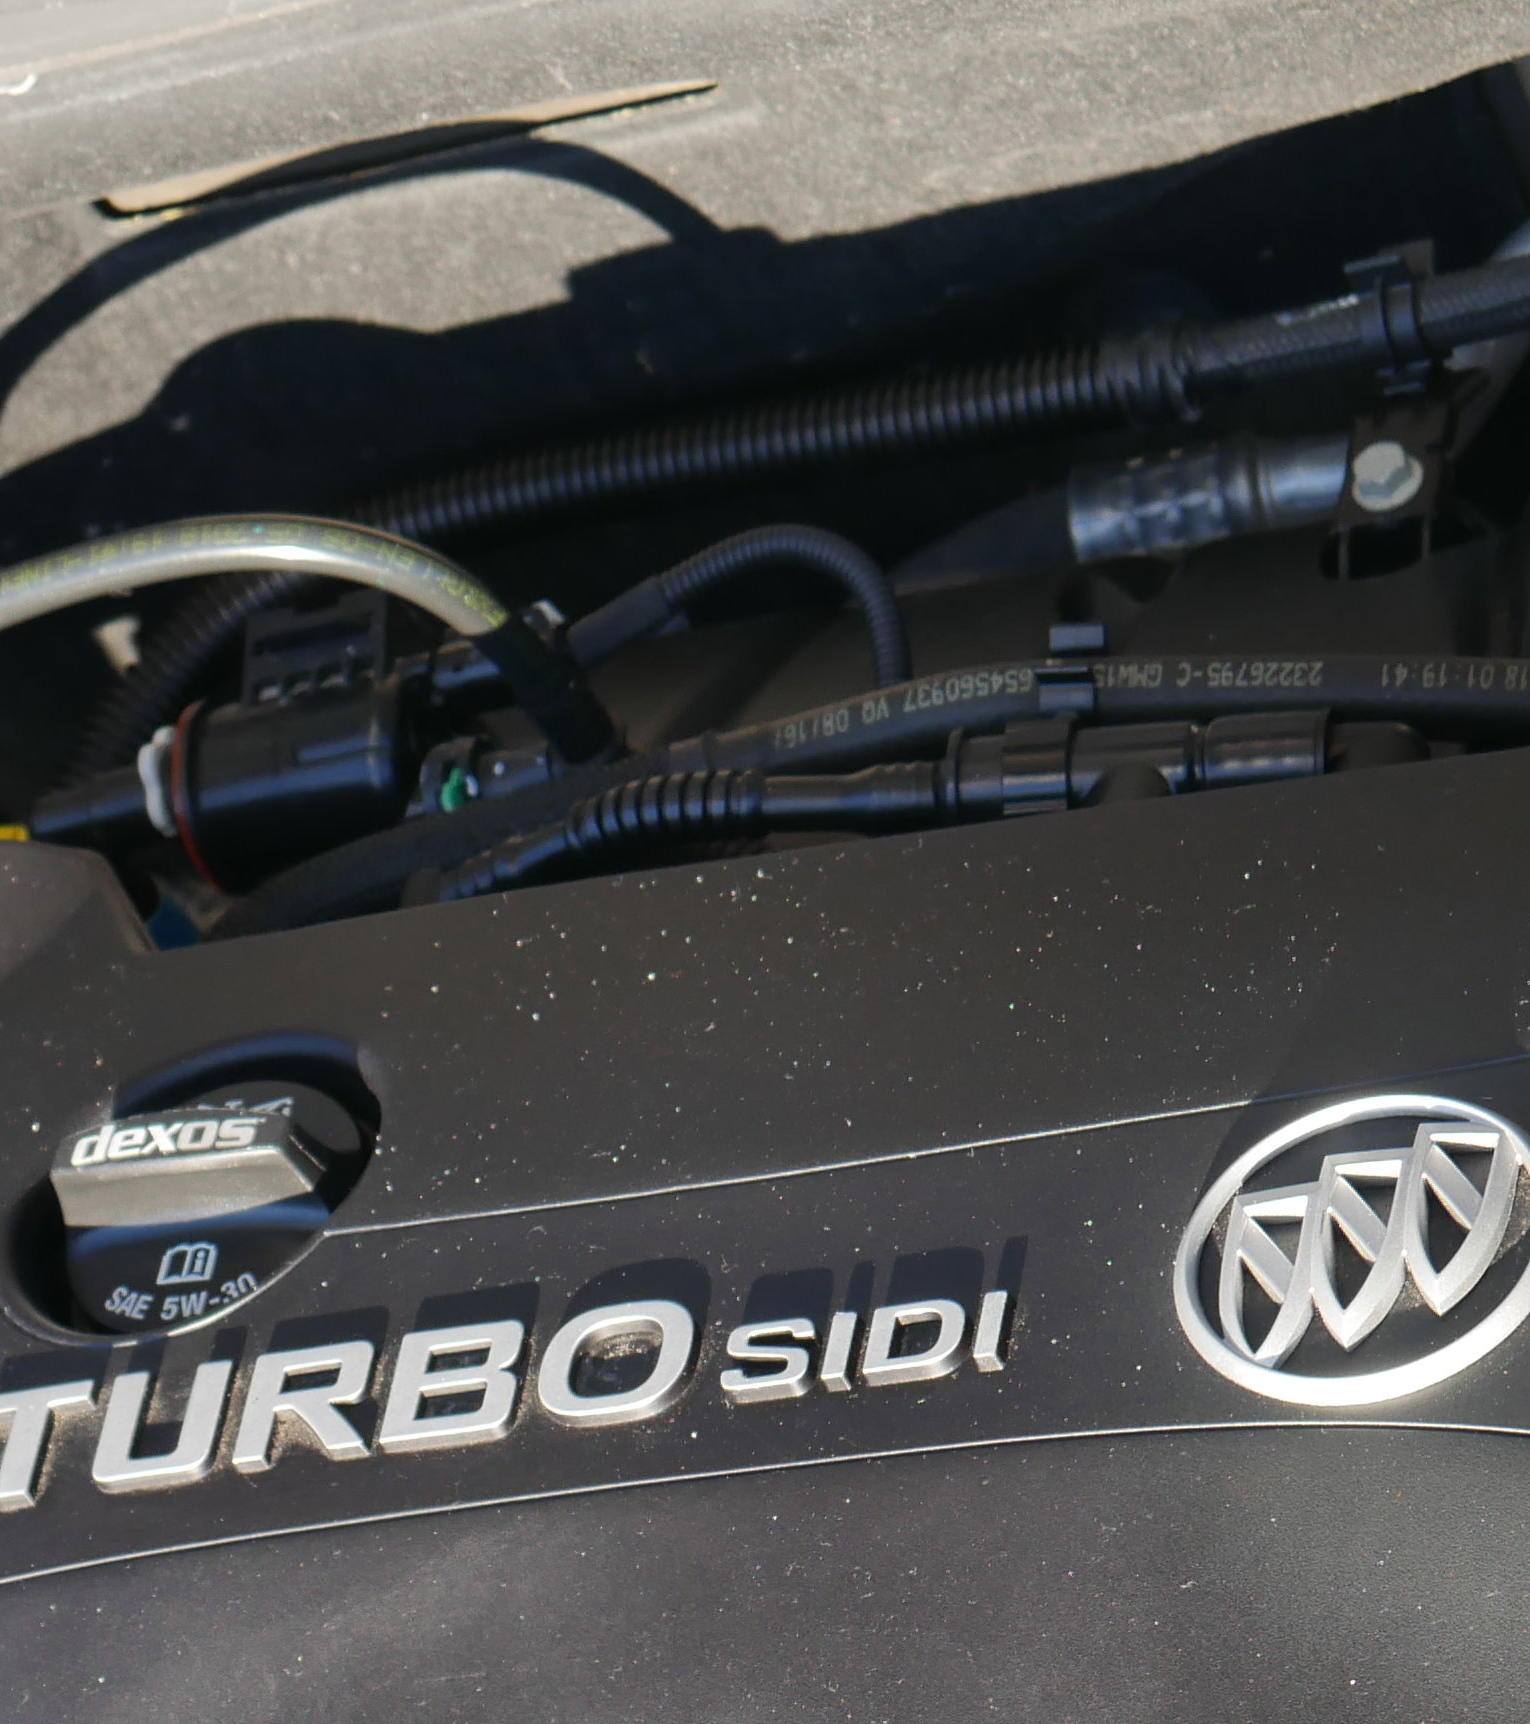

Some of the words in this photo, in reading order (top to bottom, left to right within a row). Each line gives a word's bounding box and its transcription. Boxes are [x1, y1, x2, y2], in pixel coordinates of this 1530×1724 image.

[1175, 660, 1325, 688] 23226795-C
[70, 1117, 262, 1167] dexos
[104, 1286, 153, 1320] SAE
[160, 1271, 259, 1321] 5W-30
[720, 1289, 1009, 1404] SIDI
